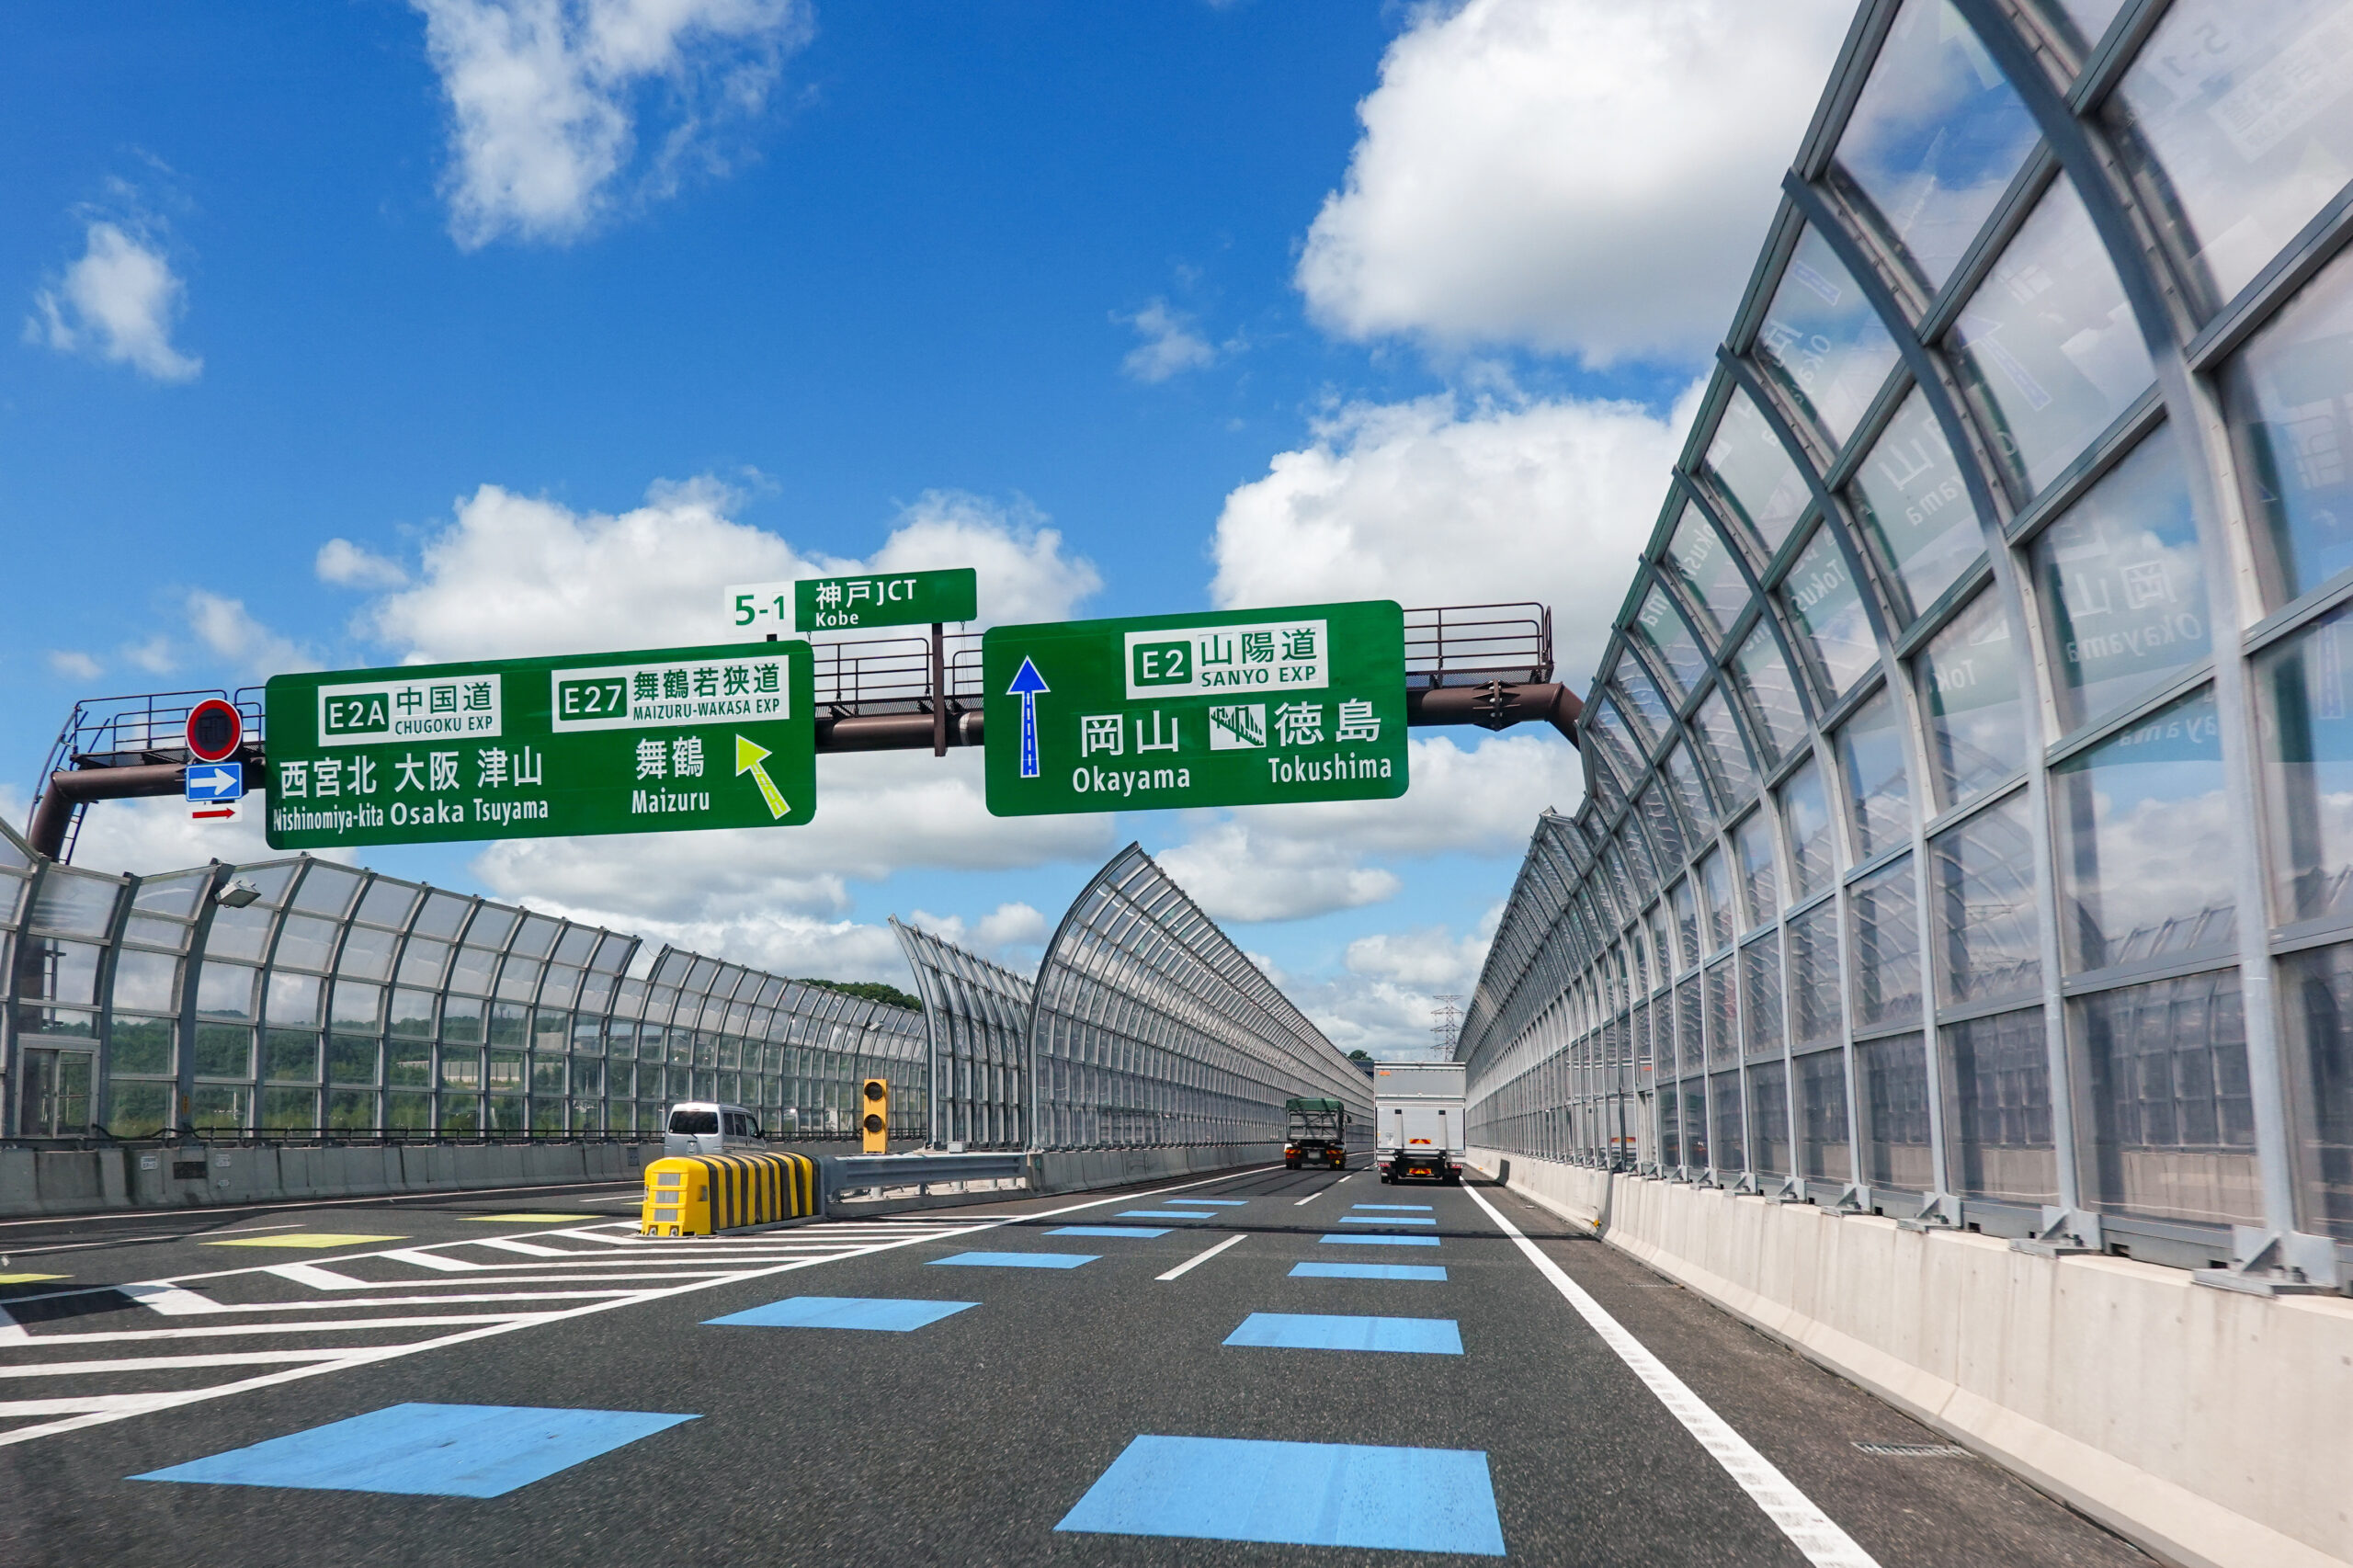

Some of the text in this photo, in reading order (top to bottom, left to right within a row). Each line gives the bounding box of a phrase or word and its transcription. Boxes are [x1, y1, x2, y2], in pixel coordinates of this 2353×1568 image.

[735, 594, 785, 627] 5-1
[815, 578, 917, 610] 神戸JCT
[815, 610, 859, 628] Kobe
[1142, 628, 1318, 680] E2 山陽道
[564, 663, 781, 714] E27 舞鶴若狭道
[1200, 665, 1317, 688] SANYO EXP
[329, 681, 494, 729] E2A 中国道
[632, 698, 780, 722] MAIZURU-WAKASA EXP
[395, 715, 494, 735] CHUGOKU EXP
[1080, 710, 1180, 758] 岡山
[1273, 698, 1382, 747] 徳島
[278, 744, 543, 800] 西宮北 大阪 津山
[635, 735, 705, 781] 舞鶴
[1267, 751, 1392, 784] Tokushima
[1072, 765, 1191, 798] Okayama
[272, 797, 550, 835] Nishinomiya-kita Osaka Tsuyama
[631, 786, 710, 814] Maizuru
